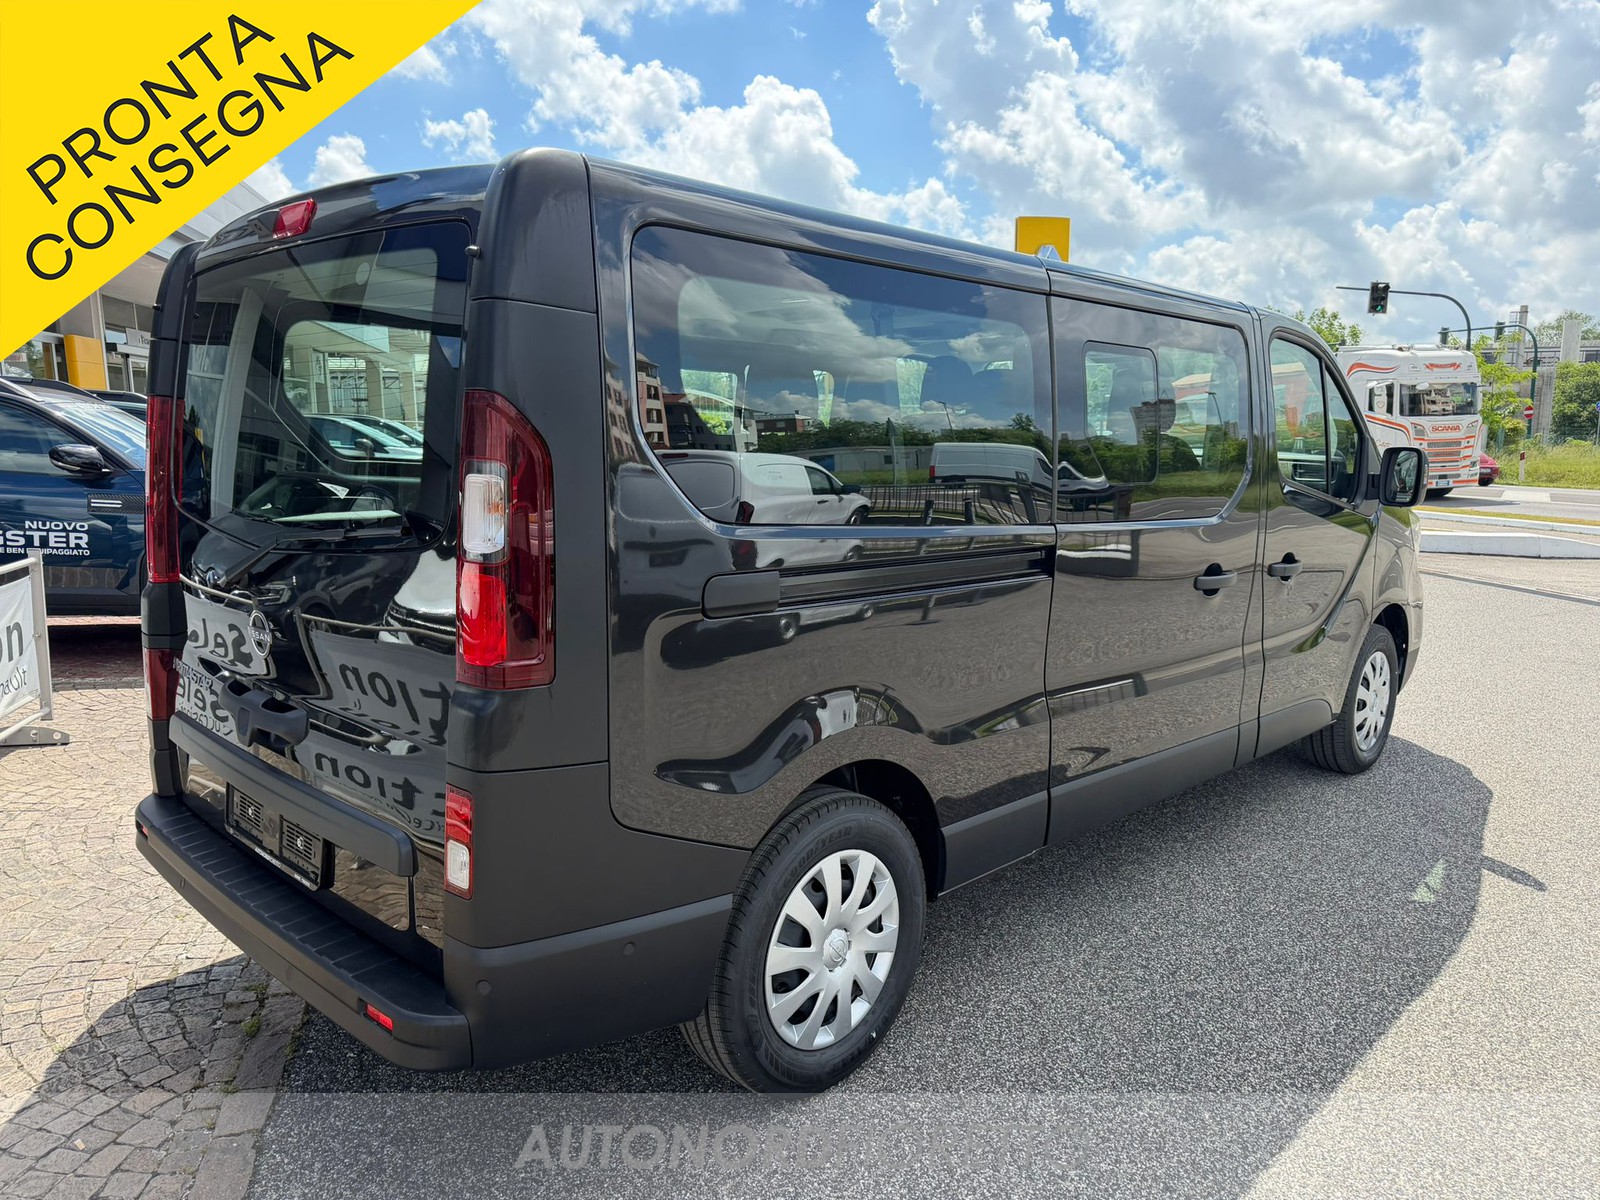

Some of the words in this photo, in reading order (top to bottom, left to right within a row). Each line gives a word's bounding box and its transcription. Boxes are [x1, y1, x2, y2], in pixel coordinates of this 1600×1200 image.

[1430, 424, 1462, 433] SCANIA
[24, 520, 89, 531] NUOVO
[0, 529, 89, 549] STER
